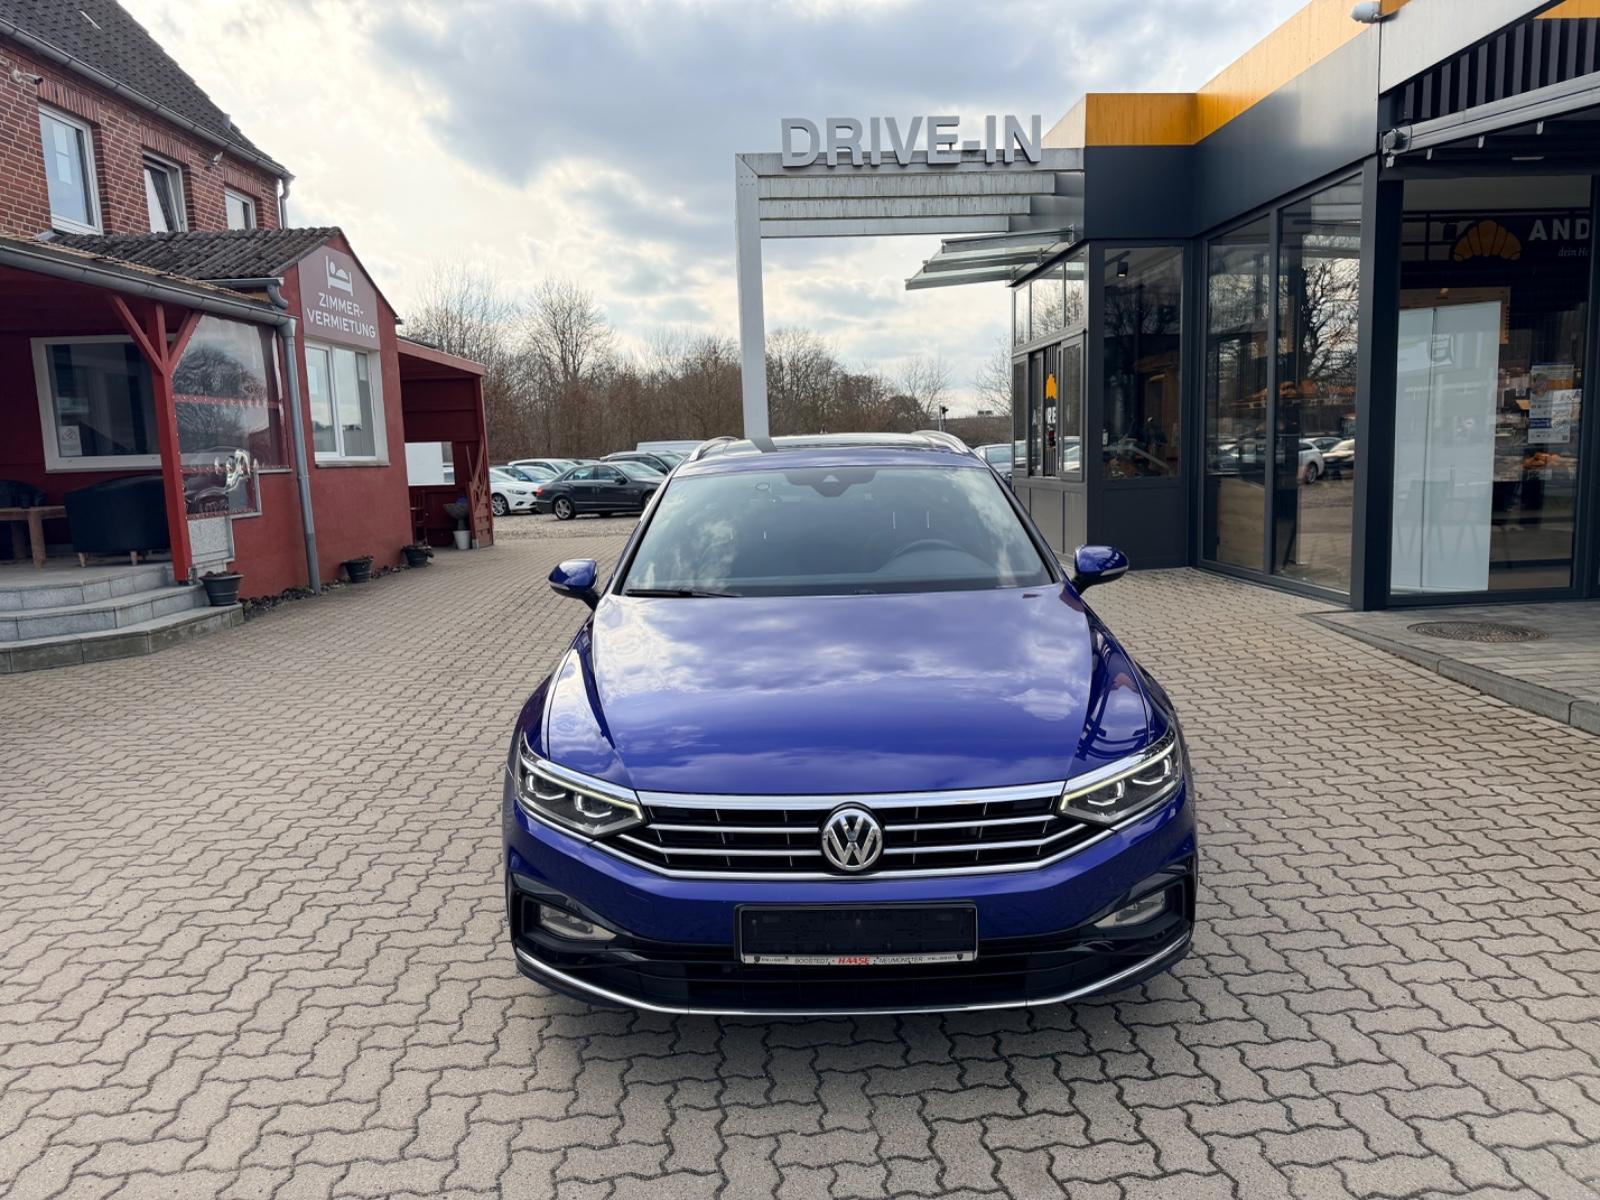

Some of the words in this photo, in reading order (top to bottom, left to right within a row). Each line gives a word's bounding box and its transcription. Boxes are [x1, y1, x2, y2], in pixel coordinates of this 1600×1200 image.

[781, 114, 1042, 168] DRIVE-IN
[318, 292, 364, 317] ZIMMER-
[307, 307, 376, 338] VERMIETUNG
[838, 956, 870, 965] HAASE
